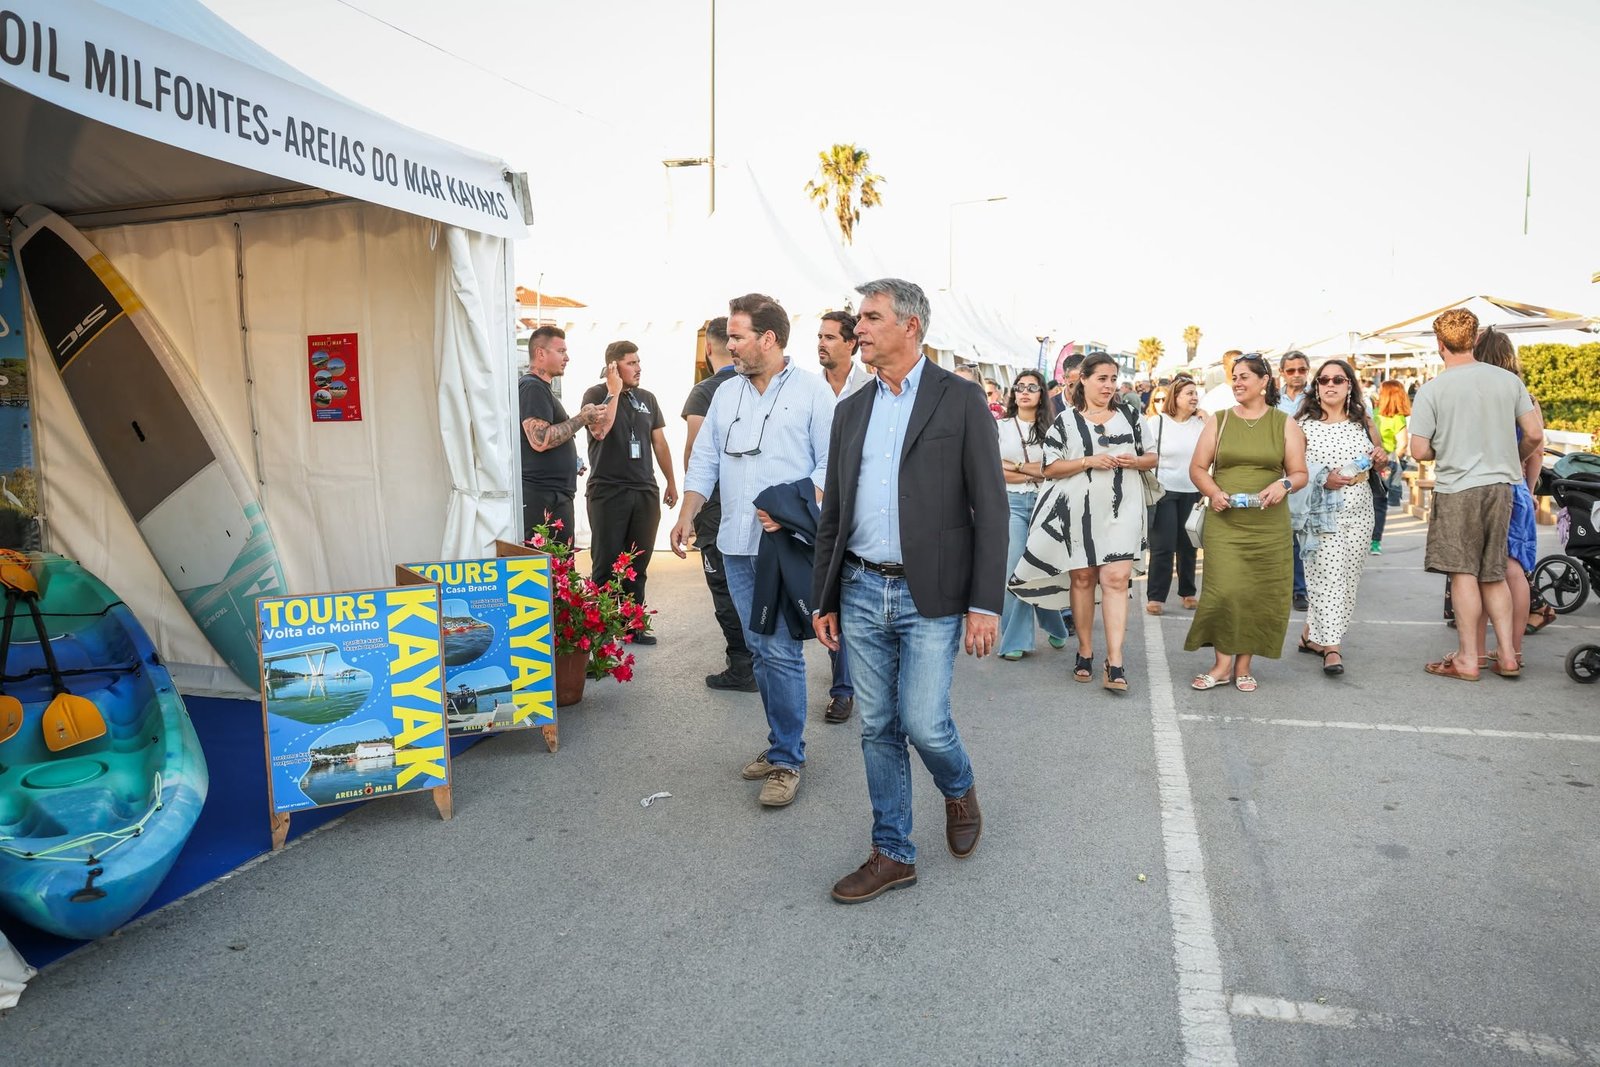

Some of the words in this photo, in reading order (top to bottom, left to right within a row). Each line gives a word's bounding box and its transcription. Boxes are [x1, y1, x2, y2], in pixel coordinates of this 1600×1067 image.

[85, 40, 366, 177] MILFONTES-AREIAS
[371, 147, 399, 188] DO
[404, 158, 443, 201] MAR
[445, 176, 510, 221] KAYAKS
[445, 586, 466, 594] Casa
[468, 584, 497, 593] Branca
[263, 593, 377, 628] TOURS
[264, 627, 303, 640] Volta
[307, 624, 325, 636] do
[329, 619, 380, 634] Moinho
[506, 558, 554, 726] KAYAK
[386, 588, 447, 790] KAYAK
[335, 789, 364, 799] AREIAS
[374, 784, 393, 793] MAR
